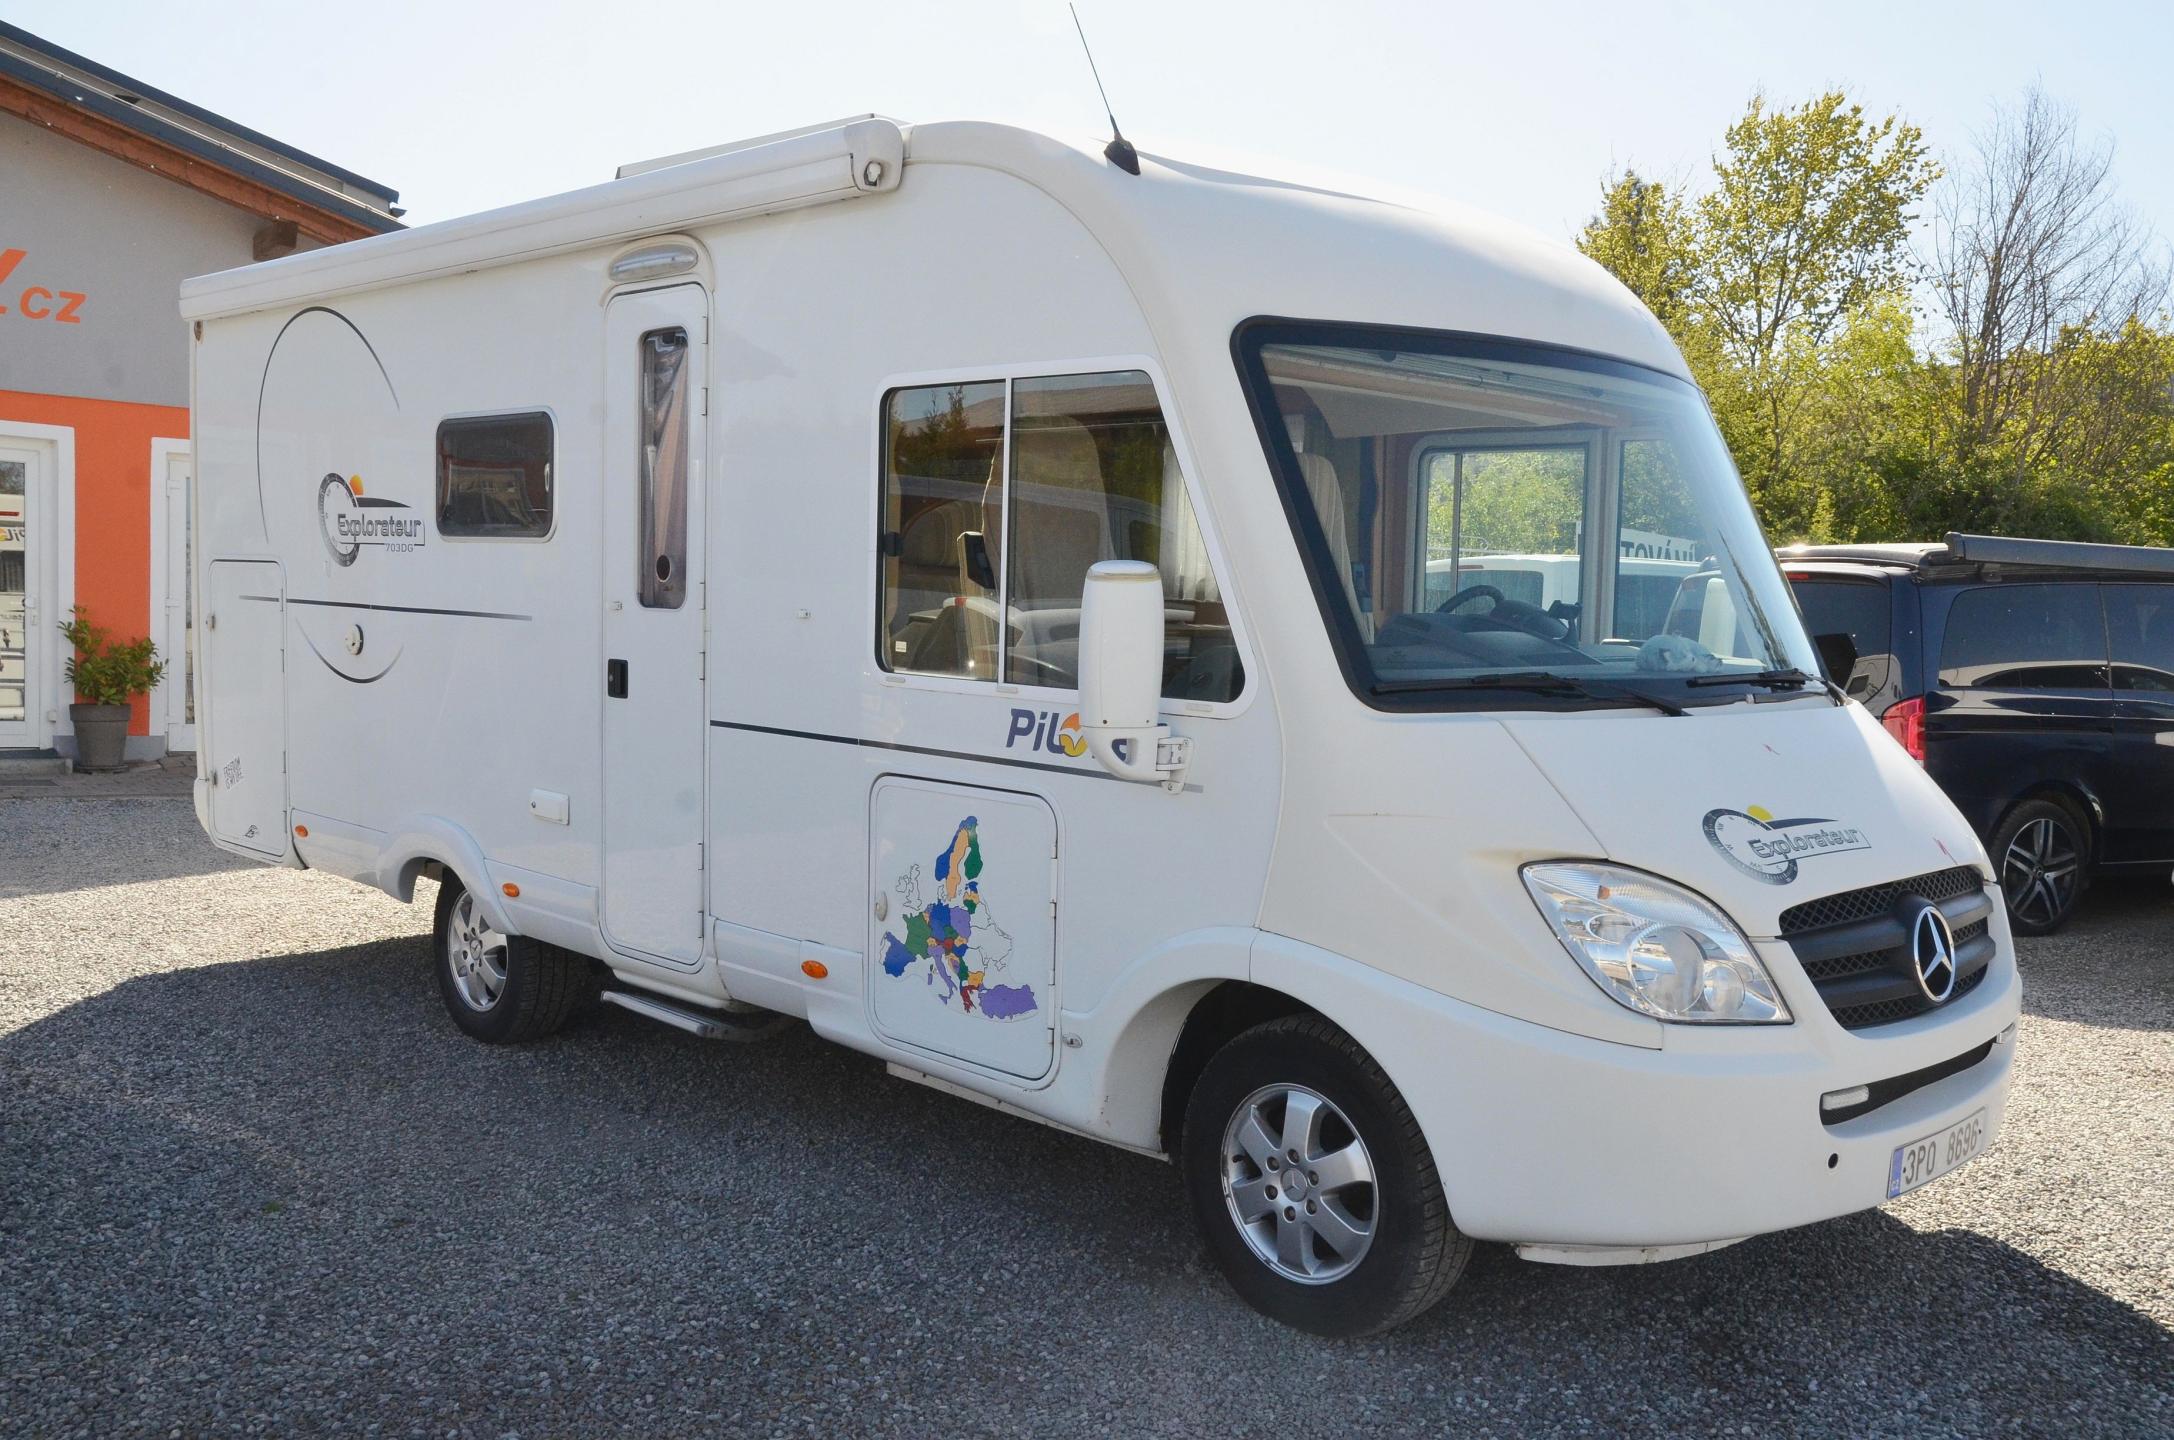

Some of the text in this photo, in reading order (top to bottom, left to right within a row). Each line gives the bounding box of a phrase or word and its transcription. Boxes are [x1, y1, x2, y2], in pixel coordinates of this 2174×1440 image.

[337, 513, 422, 542] Explorateur
[385, 543, 414, 553] 703DG
[1747, 828, 1860, 860] Explorateur
[1946, 1118, 1979, 1165] 8696
